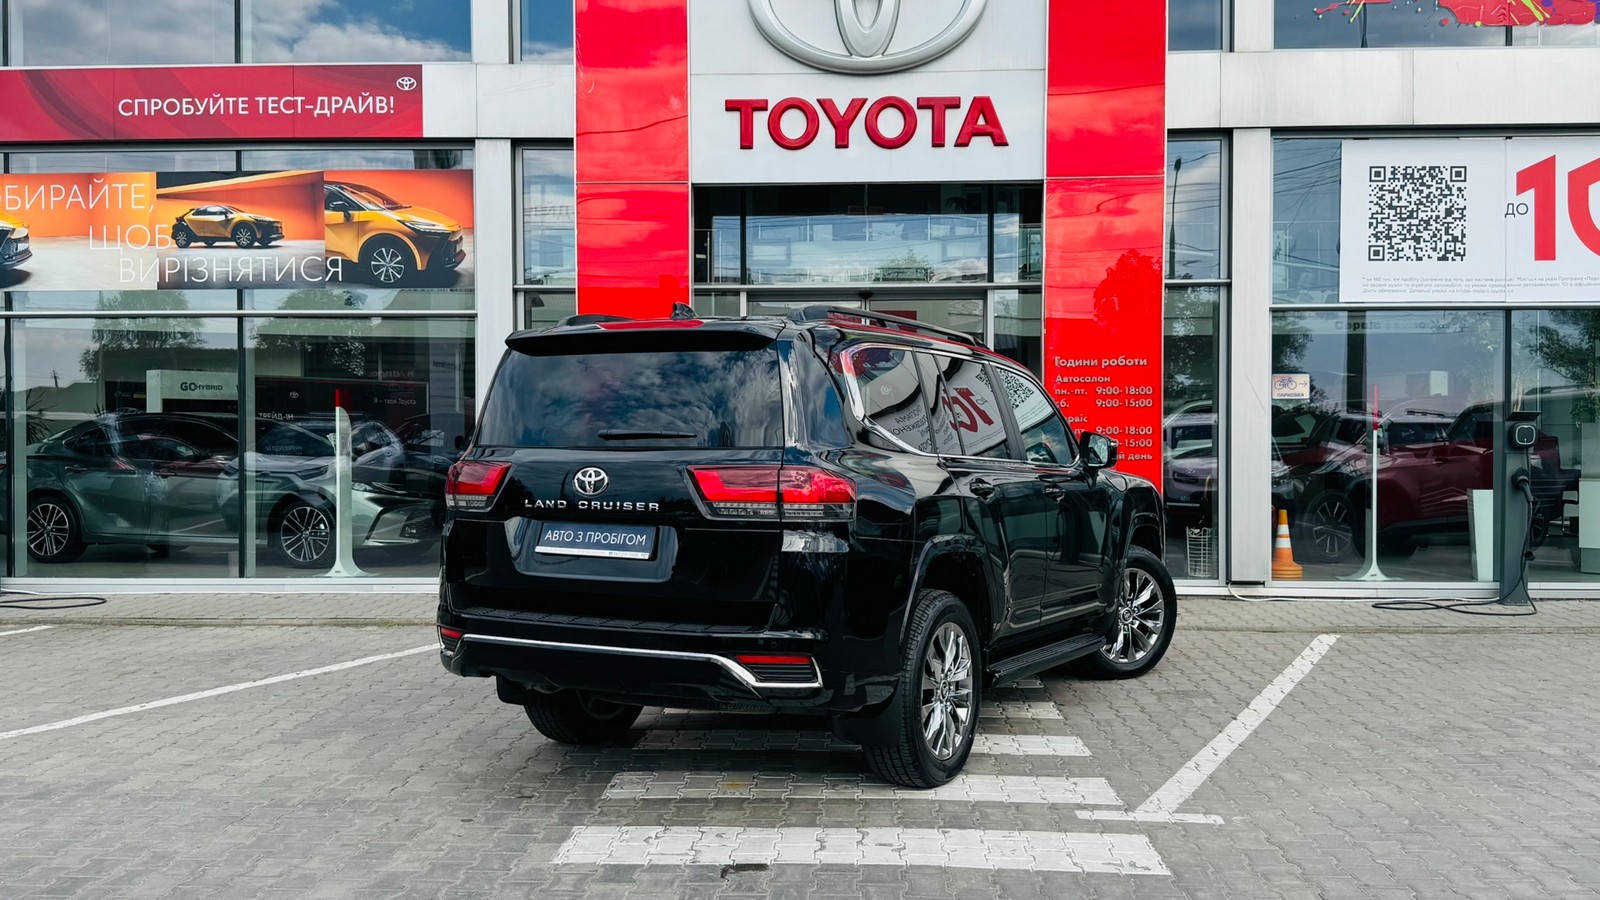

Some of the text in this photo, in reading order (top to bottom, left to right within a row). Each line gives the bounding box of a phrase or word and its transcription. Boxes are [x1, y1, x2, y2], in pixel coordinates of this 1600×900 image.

[118, 92, 395, 118] СПРОБУЙТЕ ТЕСТ-ДРАЙВ!
[725, 96, 1009, 150] TOYOTA
[0, 178, 155, 213] БИРАЙТЕ,
[1504, 203, 1529, 218] ДО
[88, 224, 172, 254] ЩОБ
[119, 255, 343, 283] ВИРІЗНЯТИСЯ
[1054, 355, 1147, 368] Години роботи
[1055, 374, 1110, 383] Автосалон
[1065, 414, 1088, 423] рвіс
[525, 499, 660, 512] LAND CRUISER
[544, 530, 574, 542] АВТО
[586, 532, 647, 546] ПРОБІГОМ
